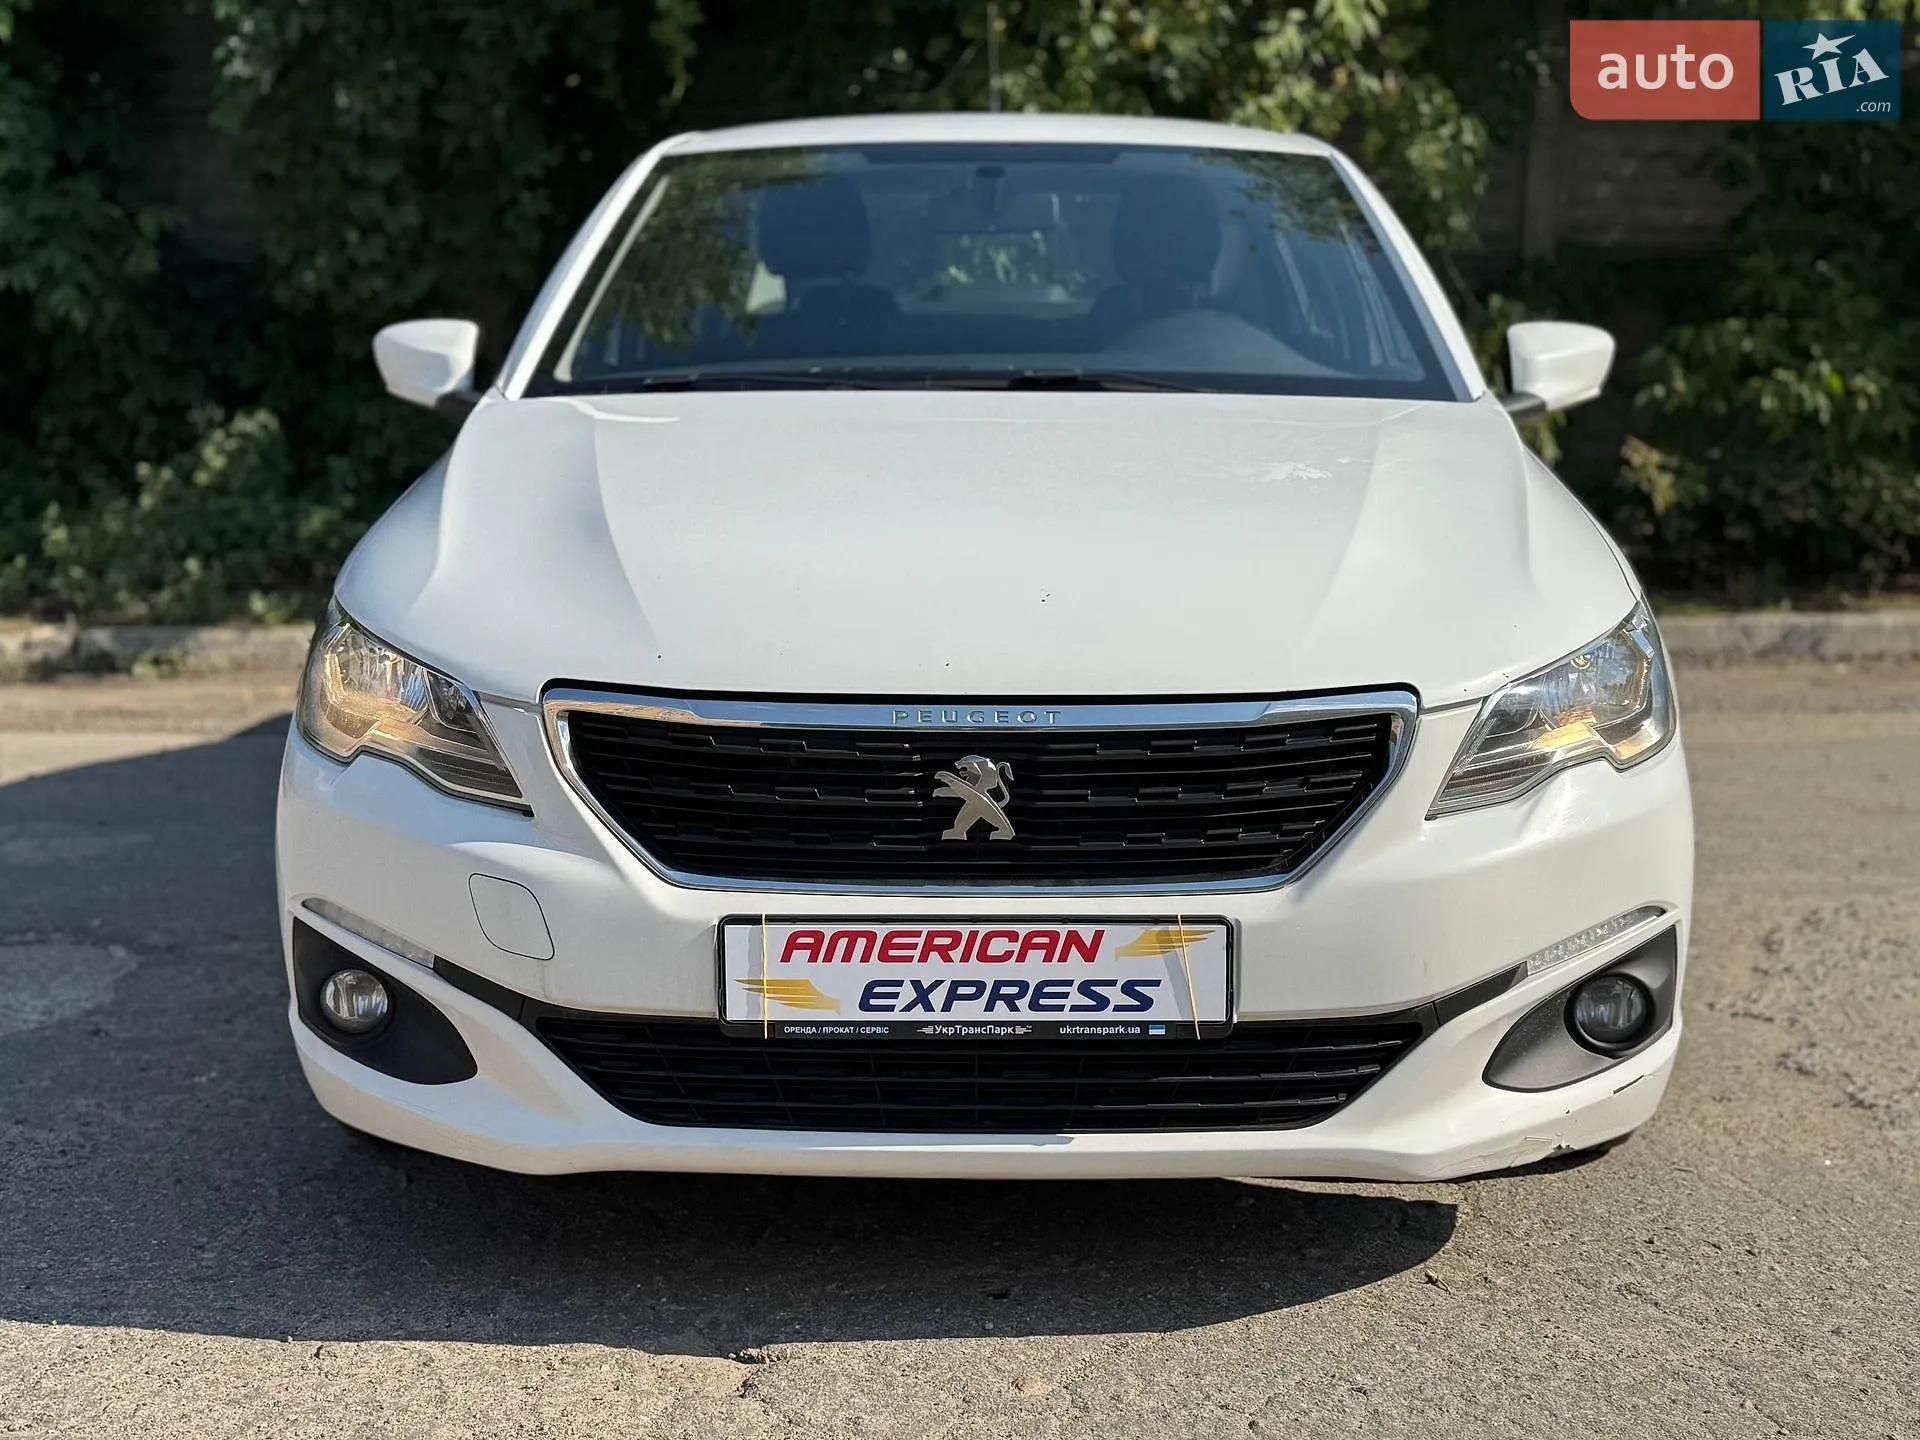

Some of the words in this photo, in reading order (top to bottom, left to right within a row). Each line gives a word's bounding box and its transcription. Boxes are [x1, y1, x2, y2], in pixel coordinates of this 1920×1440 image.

[892, 709, 1062, 725] PEUGEOT
[779, 929, 1105, 964] AMERICAN
[858, 978, 1163, 1014] EXPRESS
[783, 1026, 817, 1035] ОРЕНДА
[822, 1026, 855, 1034] ПРОКАТ
[860, 1026, 890, 1034] СЕРВІС
[934, 1025, 1014, 1036] УкрТрансПарк
[1059, 1025, 1141, 1037] ukrtranspark.ua
